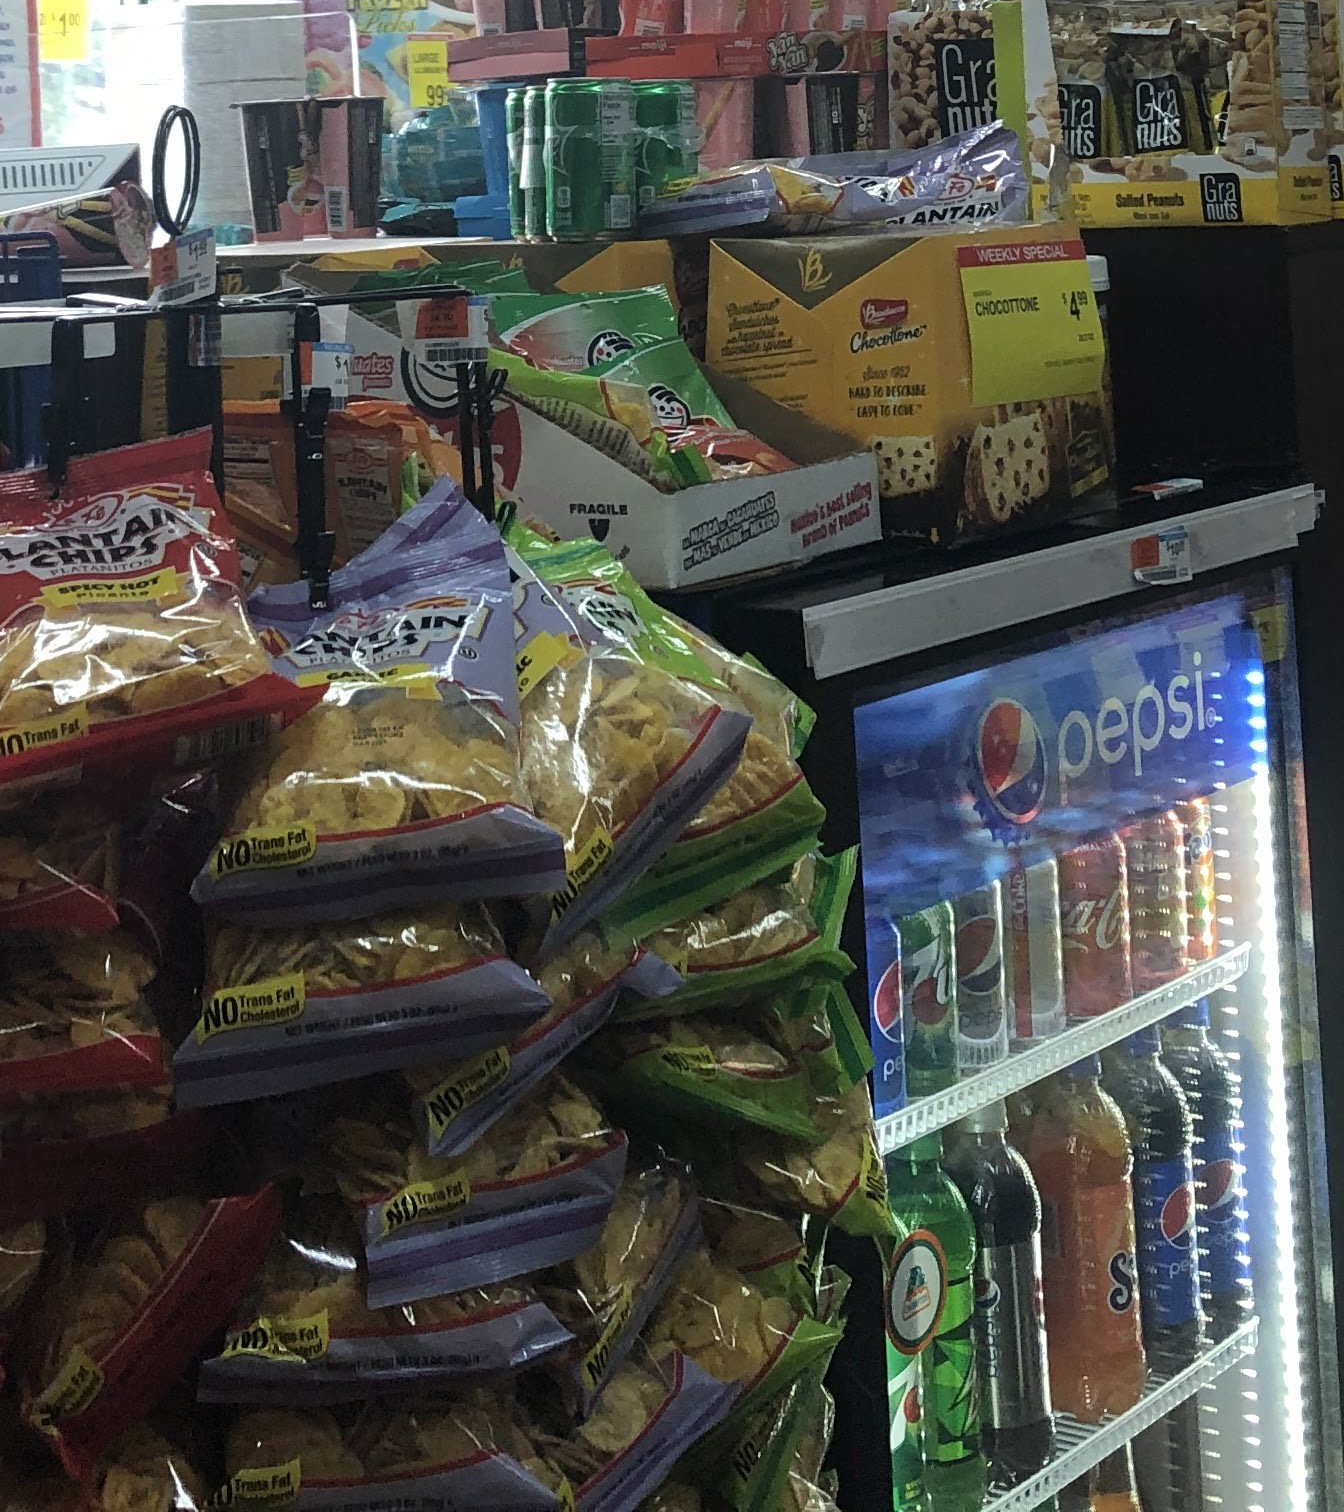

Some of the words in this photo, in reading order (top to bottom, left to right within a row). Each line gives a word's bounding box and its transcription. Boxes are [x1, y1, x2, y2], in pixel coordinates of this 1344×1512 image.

[1135, 81, 1181, 123] Gra
[1136, 115, 1183, 150] nuts
[1115, 193, 1144, 208] Salted
[1146, 192, 1185, 207] Peanuts
[1203, 175, 1238, 204] Gra
[1205, 201, 1239, 221] nuts
[976, 247, 1020, 263] WEEKLY
[1023, 244, 1069, 261] SPECIAL
[974, 296, 1041, 317] CHOCOTTONE
[849, 325, 927, 354] Chocottone
[873, 386, 885, 398] TO
[569, 503, 629, 517] FRAGILE
[29, 531, 160, 569] CHIPS
[1058, 650, 1207, 778] pepsi
[22, 728, 59, 745] Trans
[59, 717, 80, 735] Fat
[249, 831, 285, 851] Trans
[286, 828, 308, 845] Fat
[216, 842, 251, 874] NO
[251, 844, 313, 864] Cholesterol
[568, 856, 594, 884] Trans
[239, 990, 275, 1010] Trans
[275, 985, 296, 1004] Fat
[202, 998, 240, 1034] NO
[239, 1002, 301, 1024] Cholesterol
[428, 1084, 466, 1128] NO
[416, 1187, 445, 1207] Trans
[445, 1180, 464, 1201] Fat
[385, 1193, 418, 1228] NO
